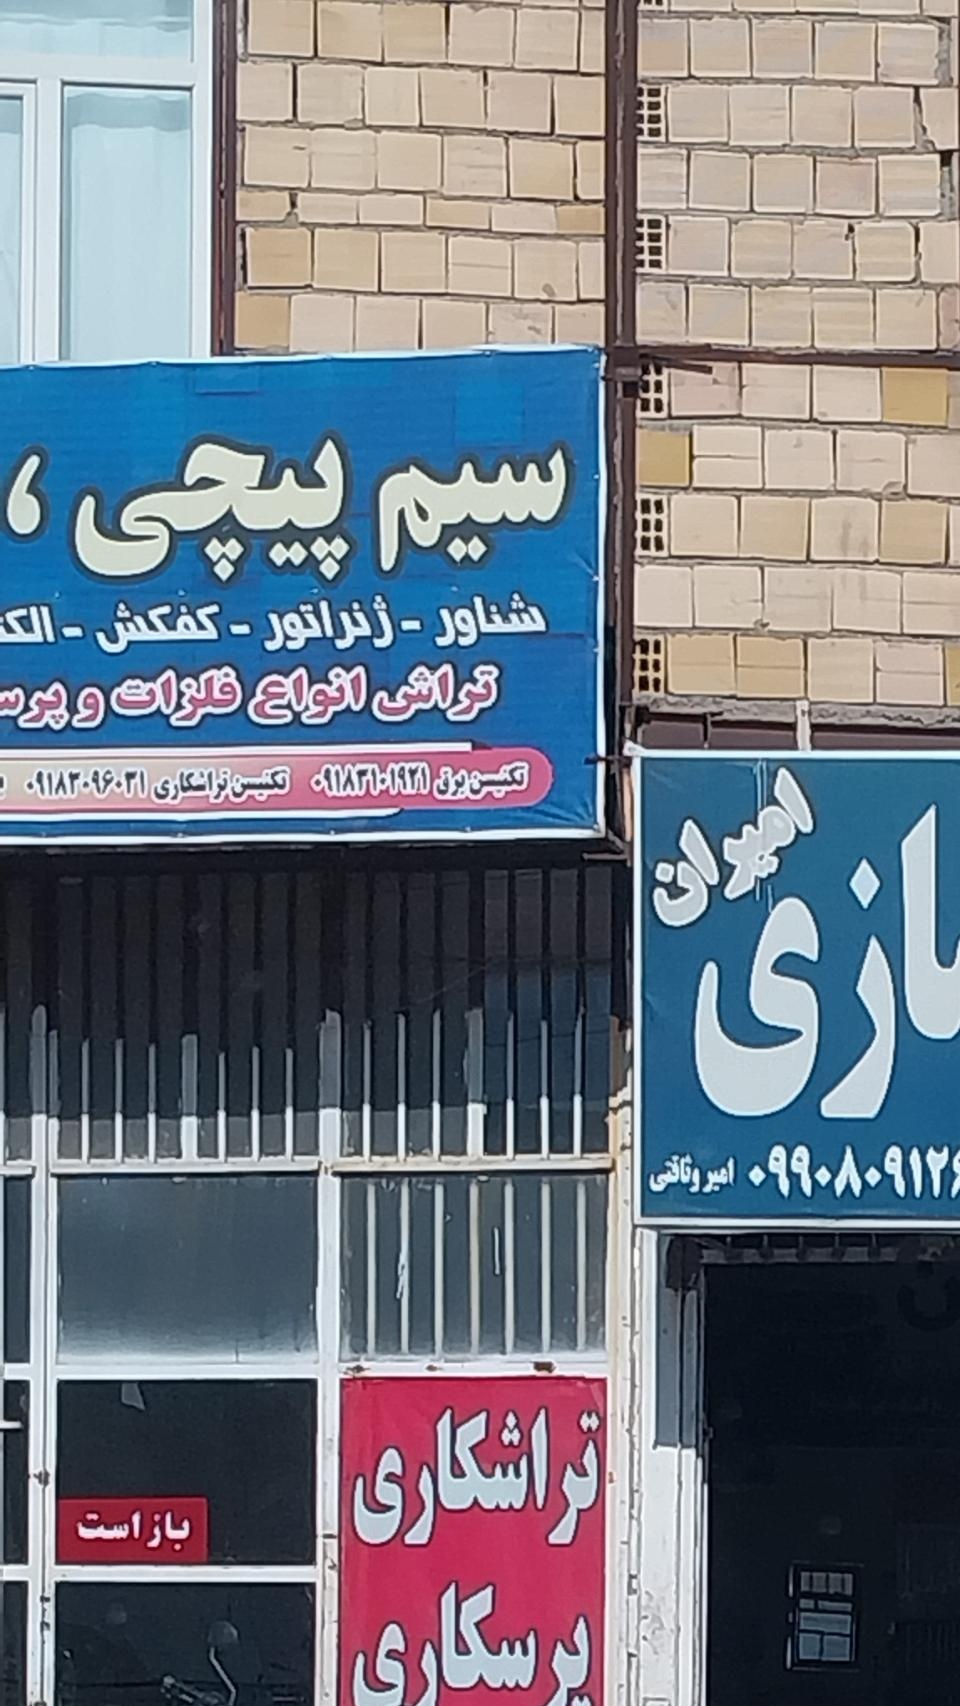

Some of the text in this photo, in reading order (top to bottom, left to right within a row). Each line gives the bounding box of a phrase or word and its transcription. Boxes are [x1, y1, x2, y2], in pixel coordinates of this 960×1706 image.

[74, 436, 350, 582] پیچی
[378, 446, 567, 572] سیم
[94, 602, 221, 654] کفکش
[262, 596, 393, 651] ژنراتور
[433, 594, 548, 647] شناور
[114, 666, 243, 727] فلزات
[247, 667, 366, 723] انواع
[373, 664, 500, 725] تراش
[653, 767, 814, 927] امیران
[352, 1407, 600, 1546] تراشکاری
[76, 1510, 191, 1551] باز است
